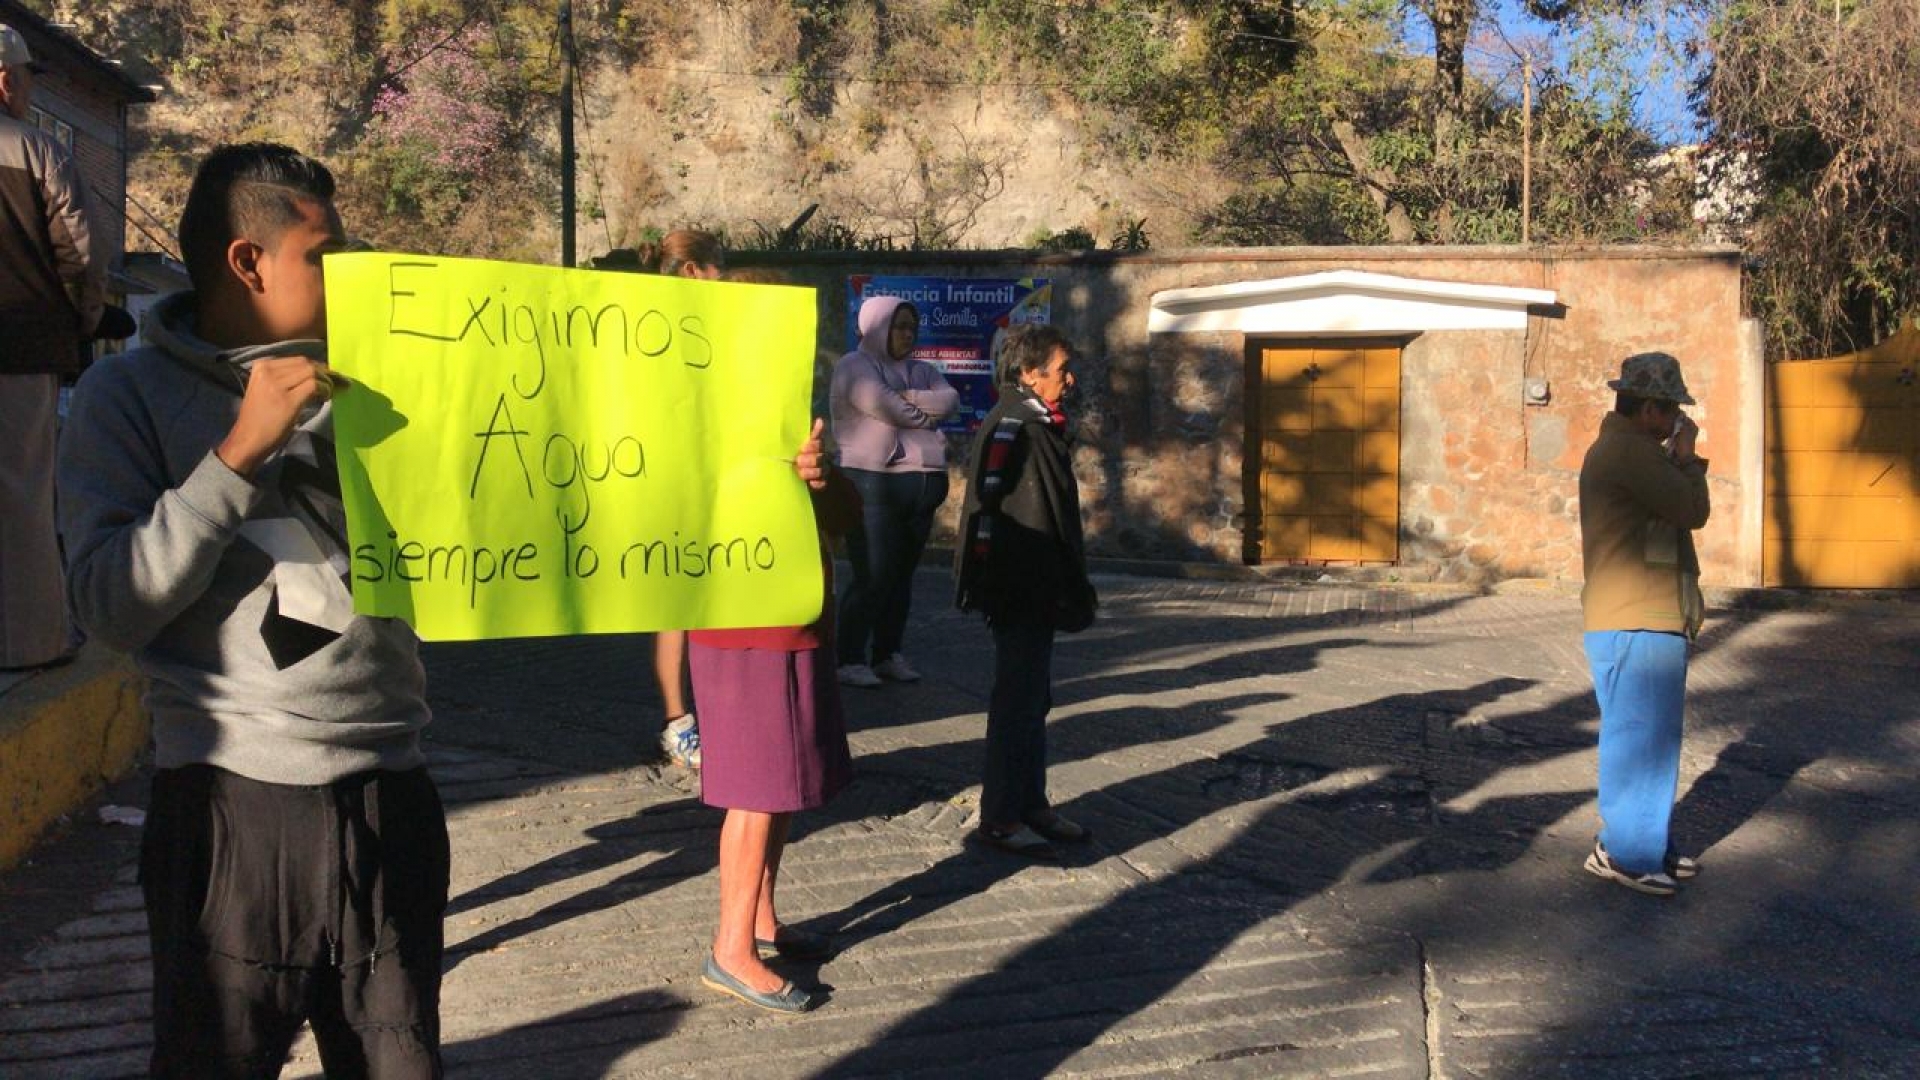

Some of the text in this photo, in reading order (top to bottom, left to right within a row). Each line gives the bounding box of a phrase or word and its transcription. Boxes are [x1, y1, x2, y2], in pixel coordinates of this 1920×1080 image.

[388, 261, 714, 400] Exigimos
[932, 306, 979, 327] Semilla
[947, 284, 1015, 304] Infantil
[470, 392, 647, 535] Agua
[355, 512, 776, 610] siempre lo mismo
